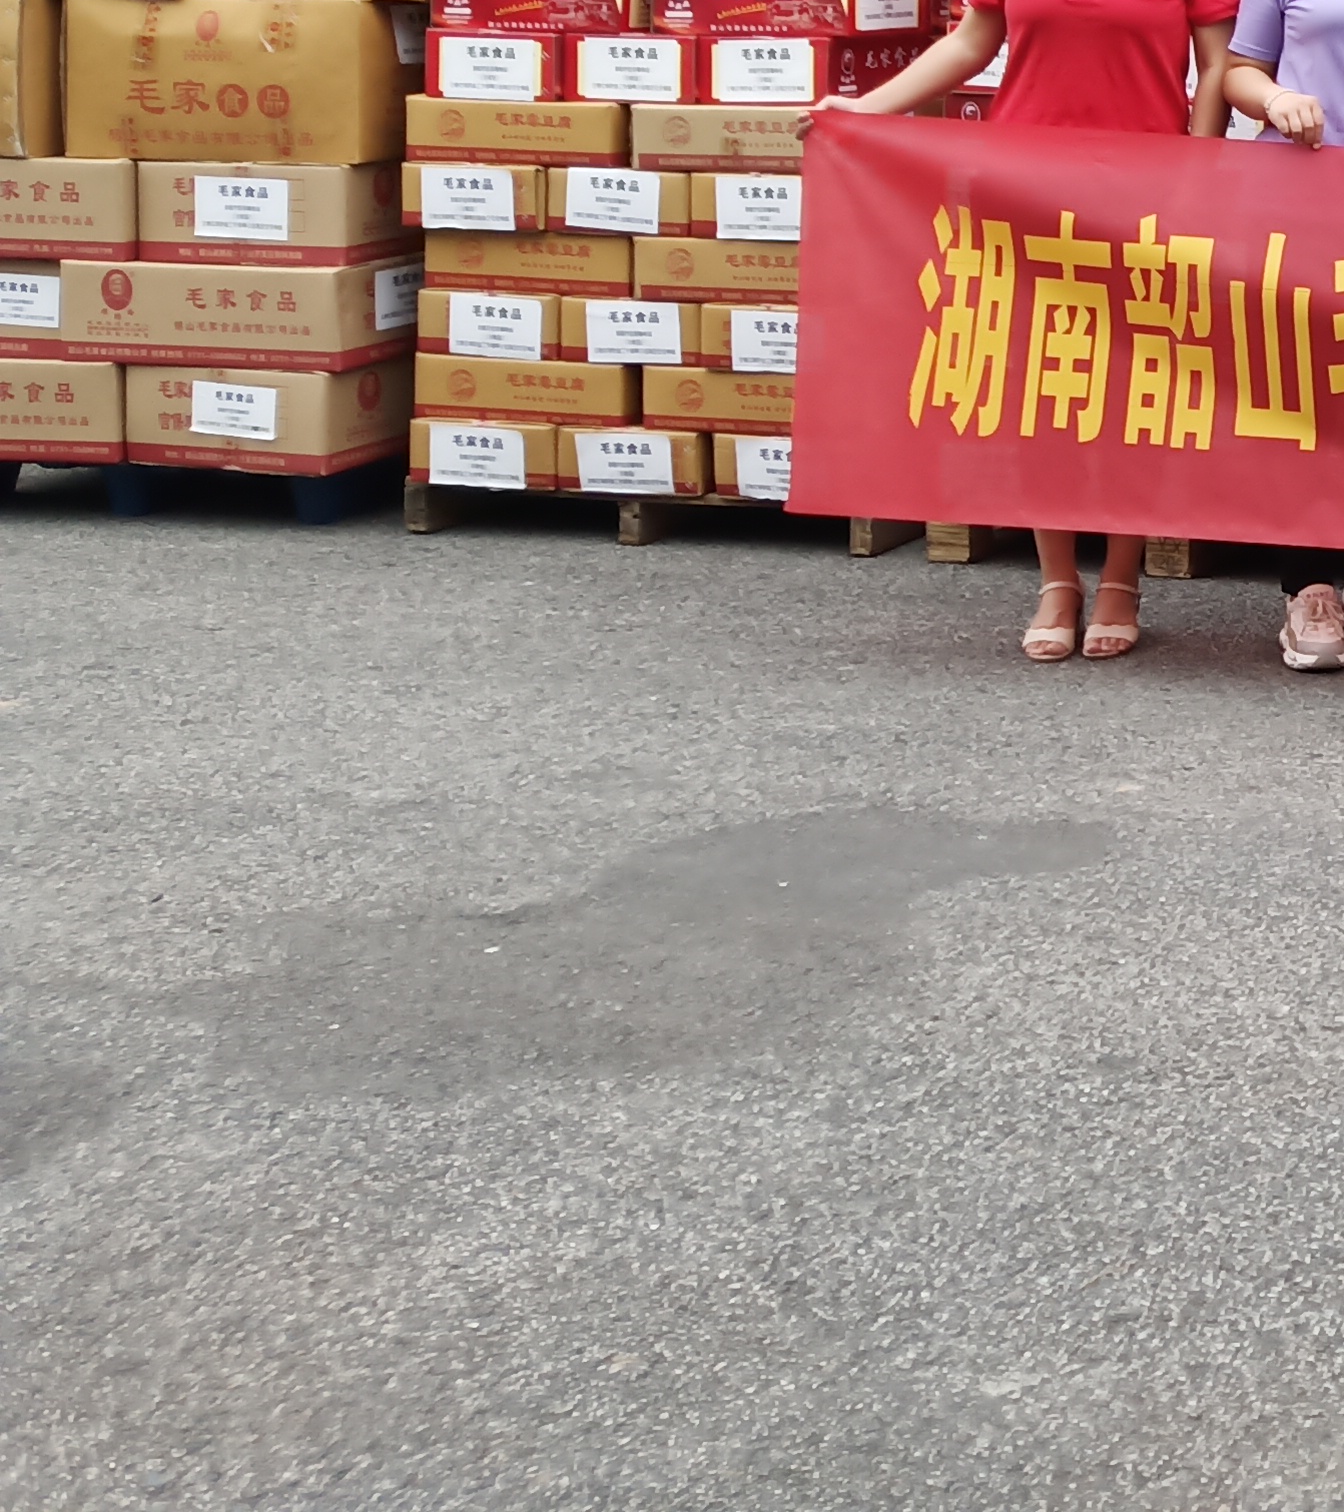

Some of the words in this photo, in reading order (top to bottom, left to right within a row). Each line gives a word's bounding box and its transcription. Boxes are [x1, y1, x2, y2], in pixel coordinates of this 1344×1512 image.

[467, 46, 516, 60] 毛家食品
[609, 46, 658, 61] 毛家食品
[742, 48, 790, 61] 毛家食品
[126, 79, 291, 119] 毛家食品
[443, 177, 494, 191] 毛家食品
[590, 177, 640, 193] 毛家食品
[218, 185, 268, 200] 毛家食品
[738, 187, 788, 200] 毛家食品
[185, 287, 296, 312] 毛家食品
[472, 305, 522, 321] 毛家食品
[607, 311, 660, 324] 毛家食品
[754, 320, 798, 334] 毛家食
[215, 390, 254, 405] 毛家食品
[452, 435, 504, 450] 毛家食品
[600, 442, 652, 455] 毛家食品
